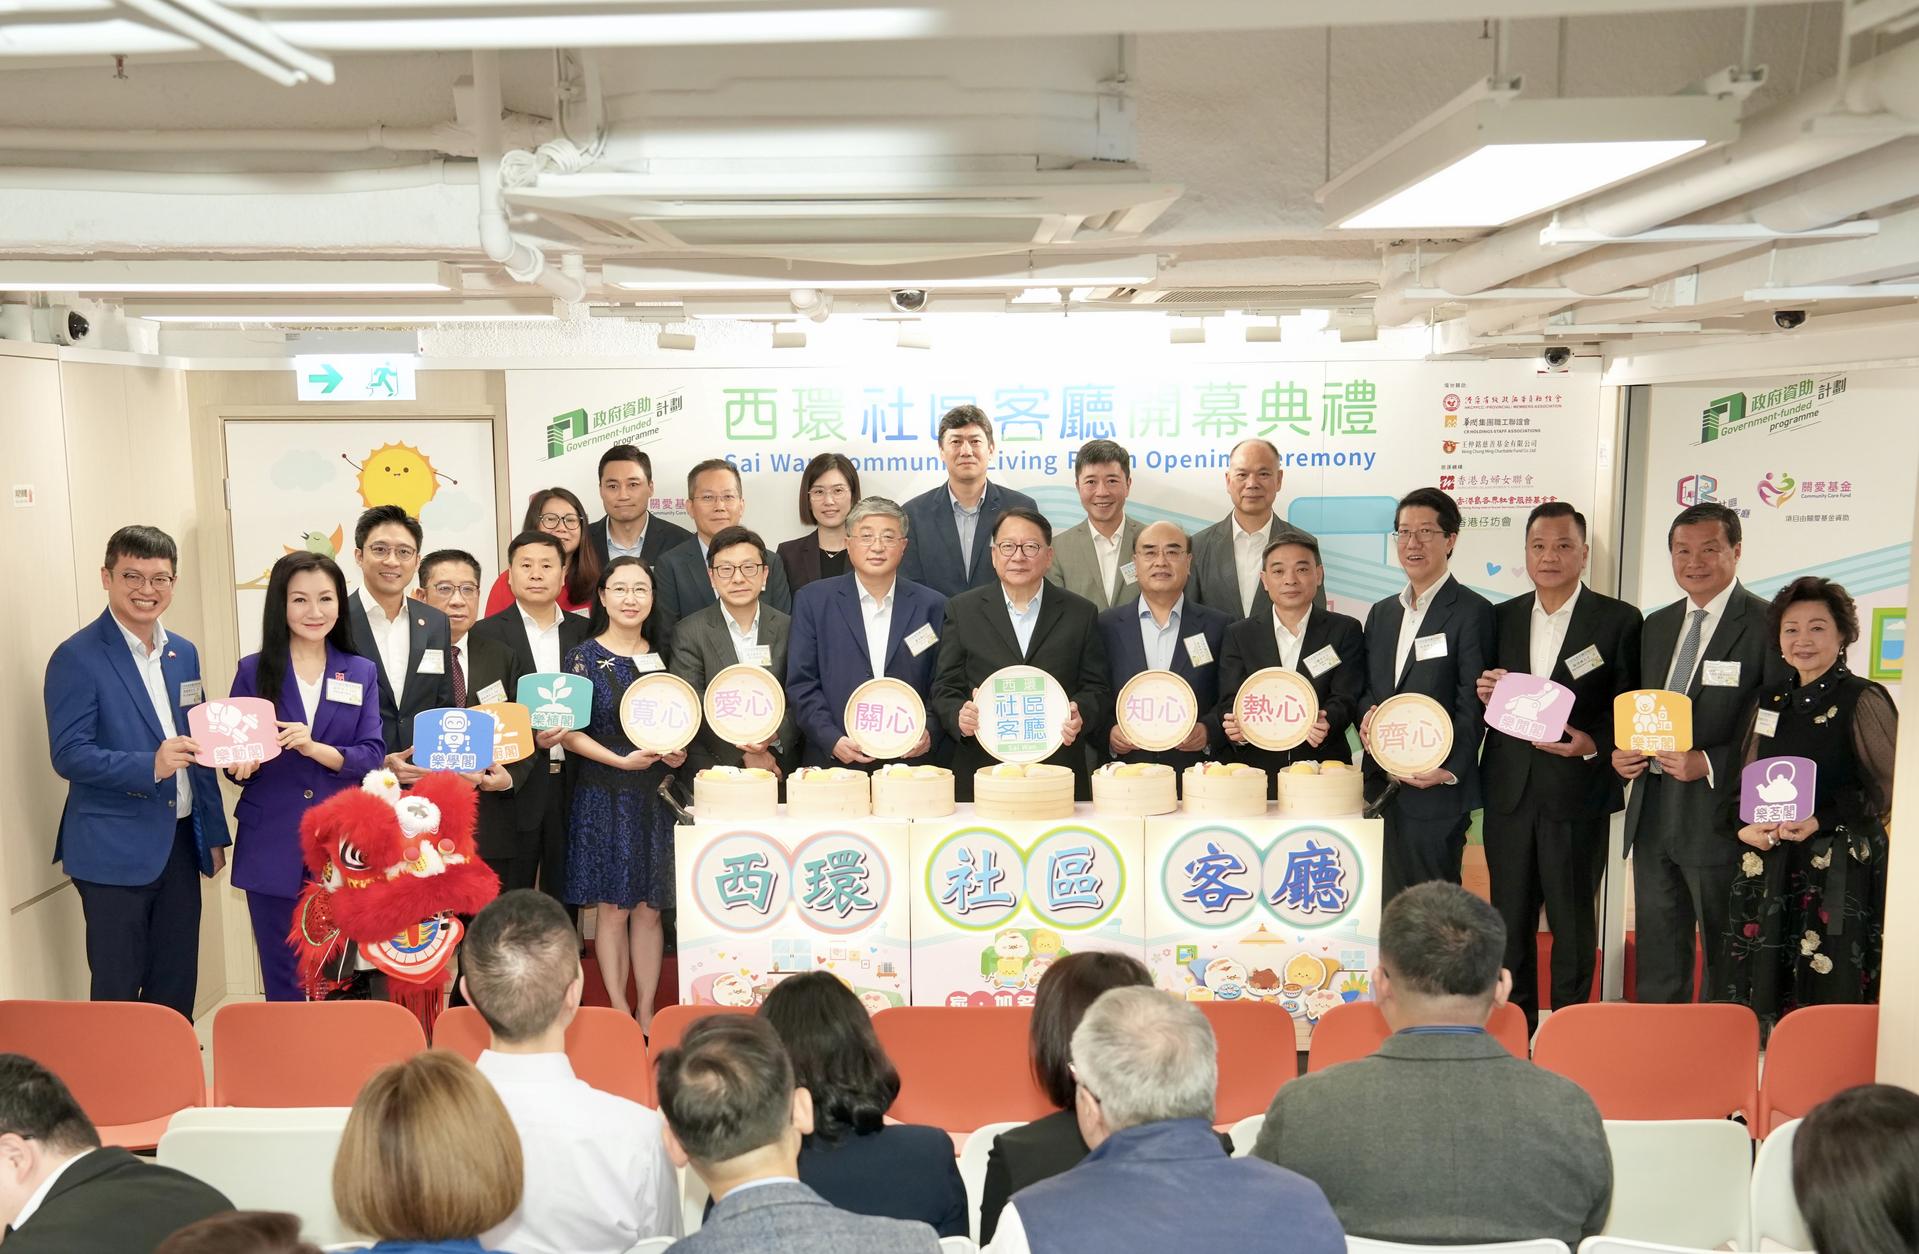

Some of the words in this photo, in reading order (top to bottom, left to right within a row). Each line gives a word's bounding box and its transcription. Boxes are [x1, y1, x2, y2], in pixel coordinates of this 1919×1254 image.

[1751, 379, 1814, 412] 政府資助
[1818, 378, 1847, 400] 計劃
[593, 396, 651, 428] 政府資助
[656, 395, 683, 418] 計劃
[1721, 400, 1813, 436] Government-funded
[1770, 410, 1819, 432] programme
[566, 418, 652, 452] Government-funded
[613, 427, 659, 447] programme
[770, 453, 813, 472] Wa
[1146, 449, 1230, 473] Openin
[1801, 481, 1852, 493] 關愛基金
[629, 698, 690, 729] 寬心
[715, 688, 773, 718] 愛心
[995, 694, 1046, 717] 社區
[1126, 694, 1186, 724] 知心
[1243, 693, 1306, 723] 熱心
[855, 702, 915, 735] 關心
[996, 718, 1047, 742] 客廳
[1378, 719, 1442, 752] 齊心
[430, 753, 476, 769] 樂學閣
[1754, 803, 1797, 823] 樂茗閣
